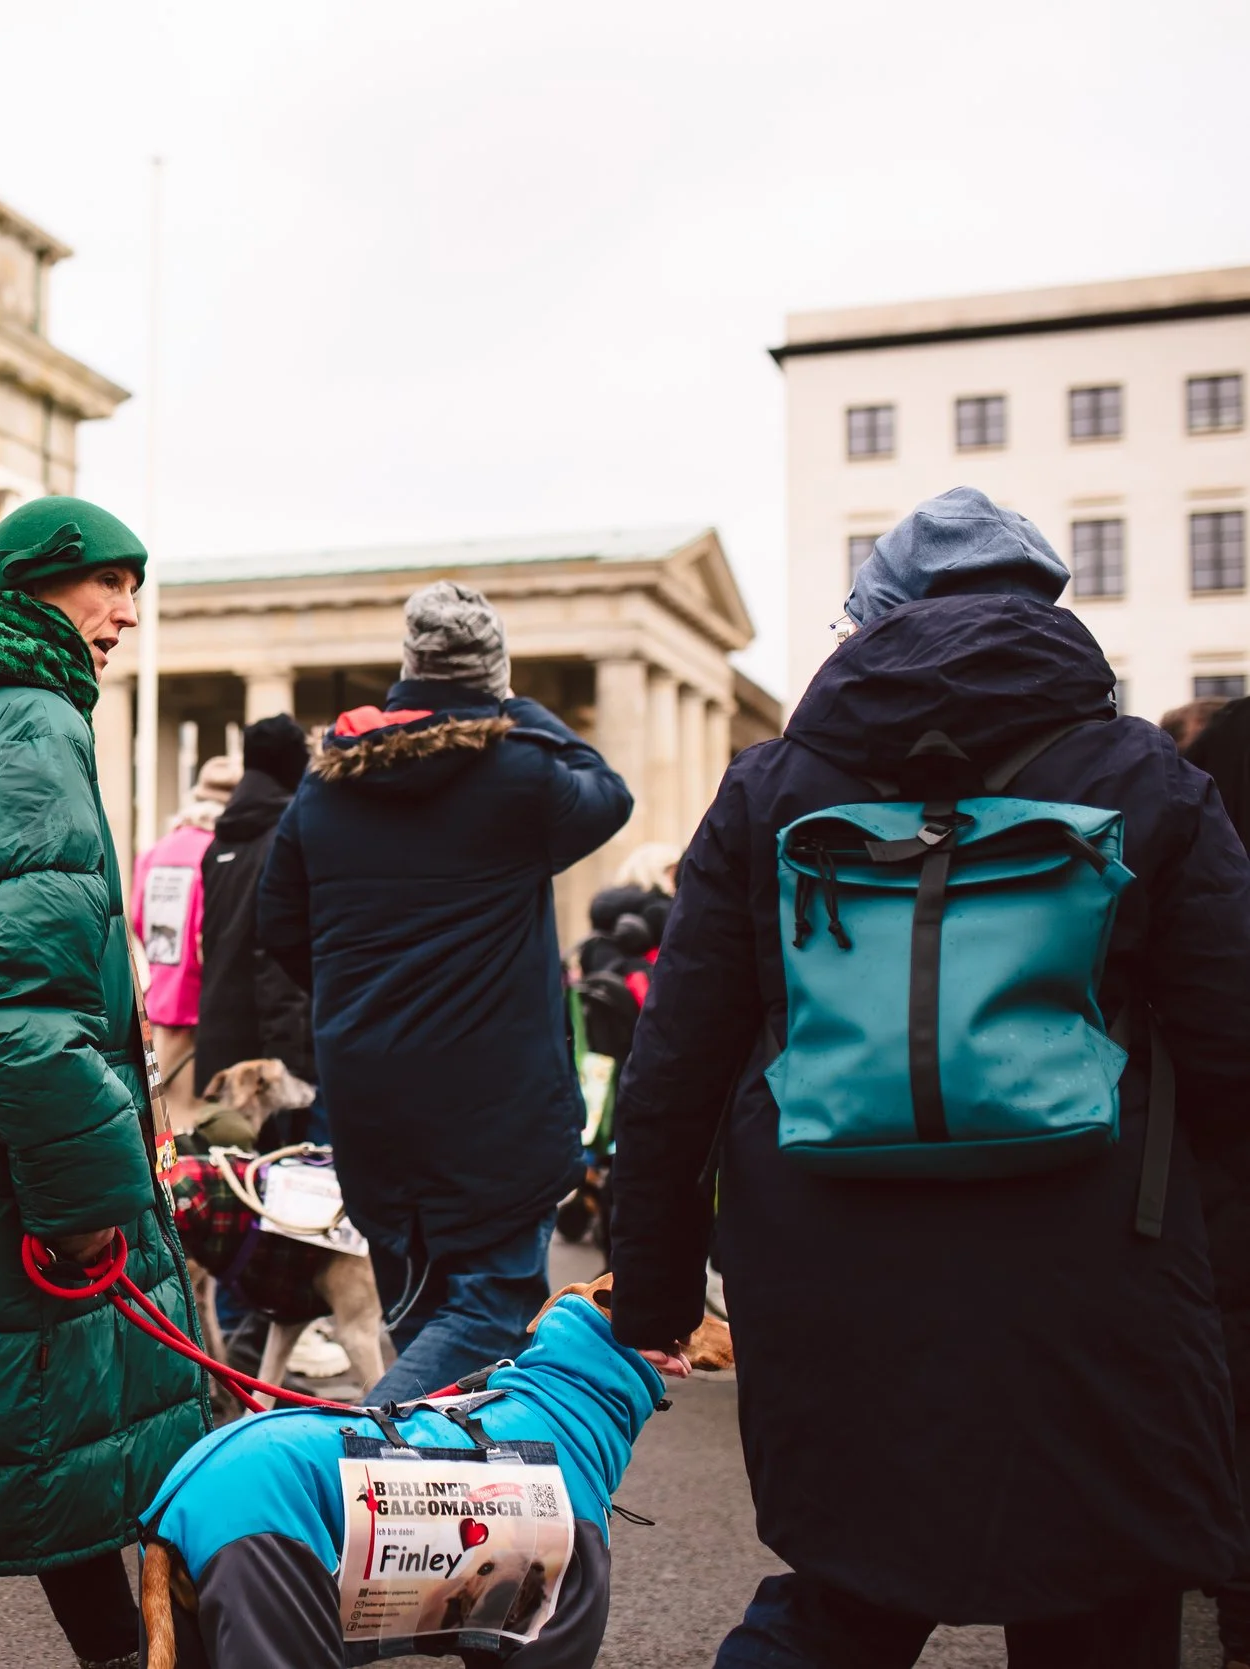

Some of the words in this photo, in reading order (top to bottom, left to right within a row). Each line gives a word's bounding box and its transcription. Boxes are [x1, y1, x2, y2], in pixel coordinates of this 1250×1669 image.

[373, 1481, 471, 1498] BERLINER
[377, 1500, 523, 1517] GALGOMARSCH
[376, 1527, 386, 1536] Ich
[387, 1527, 397, 1536] bin
[398, 1527, 416, 1536] dabei
[379, 1544, 462, 1579] Finley
